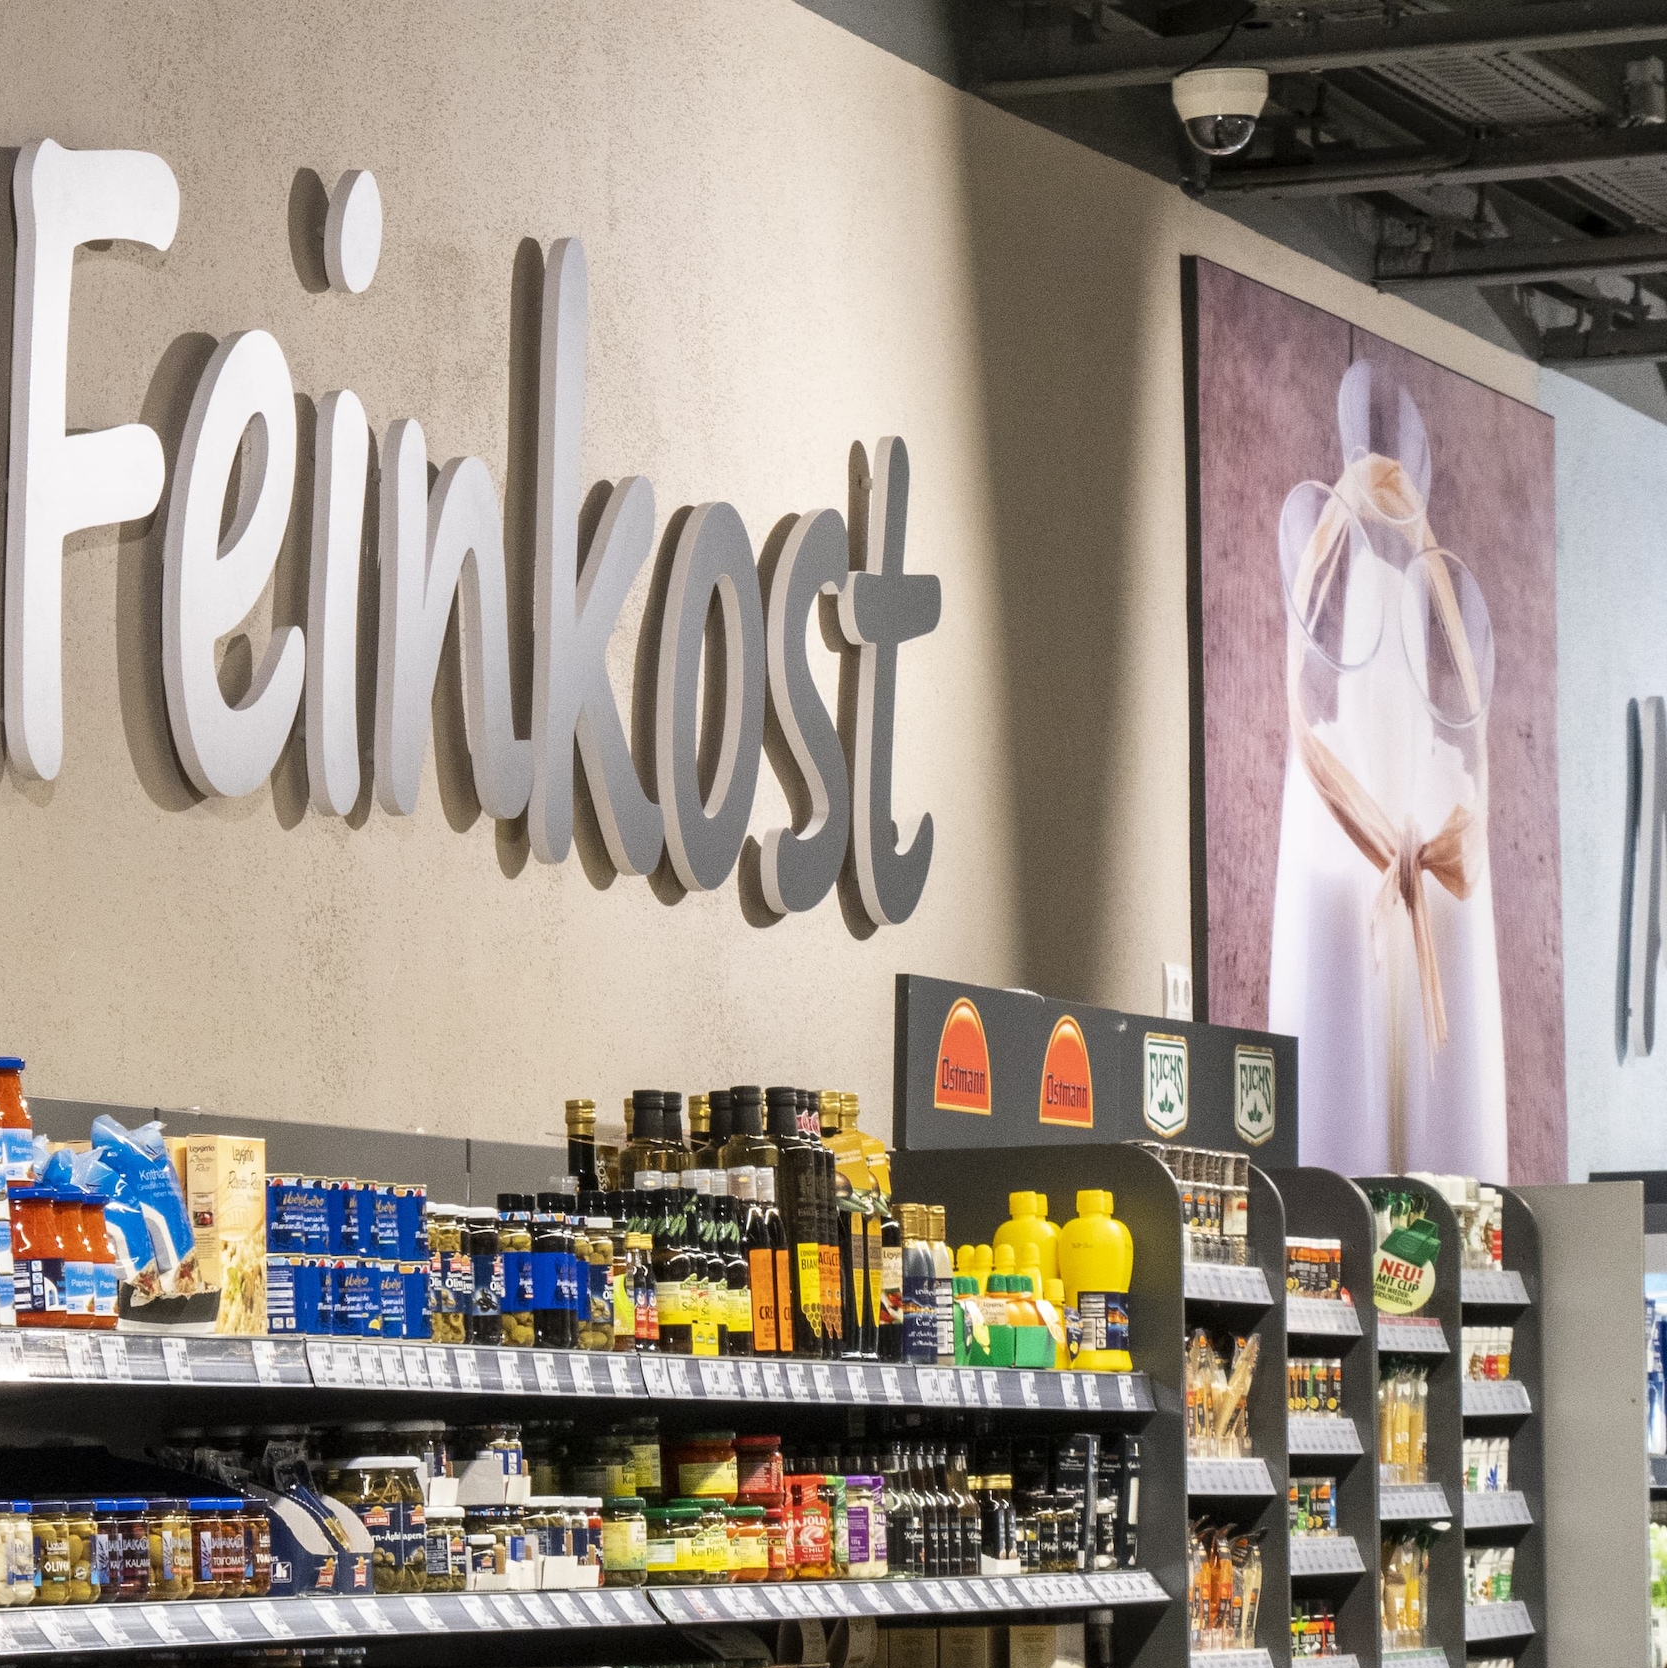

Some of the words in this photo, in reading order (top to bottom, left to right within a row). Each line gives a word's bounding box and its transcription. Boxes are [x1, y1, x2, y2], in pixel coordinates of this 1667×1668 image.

[5, 138, 941, 927] Feinkost
[942, 1056, 985, 1095] Ostmann
[1149, 1051, 1185, 1085] FUCHS
[1239, 1063, 1271, 1094] FUCHS
[1047, 1072, 1088, 1108] Ostmann
[1378, 1273, 1394, 1284] MIT
[1397, 1279, 1419, 1293] CLIP
[1379, 1258, 1424, 1284] NEU!
